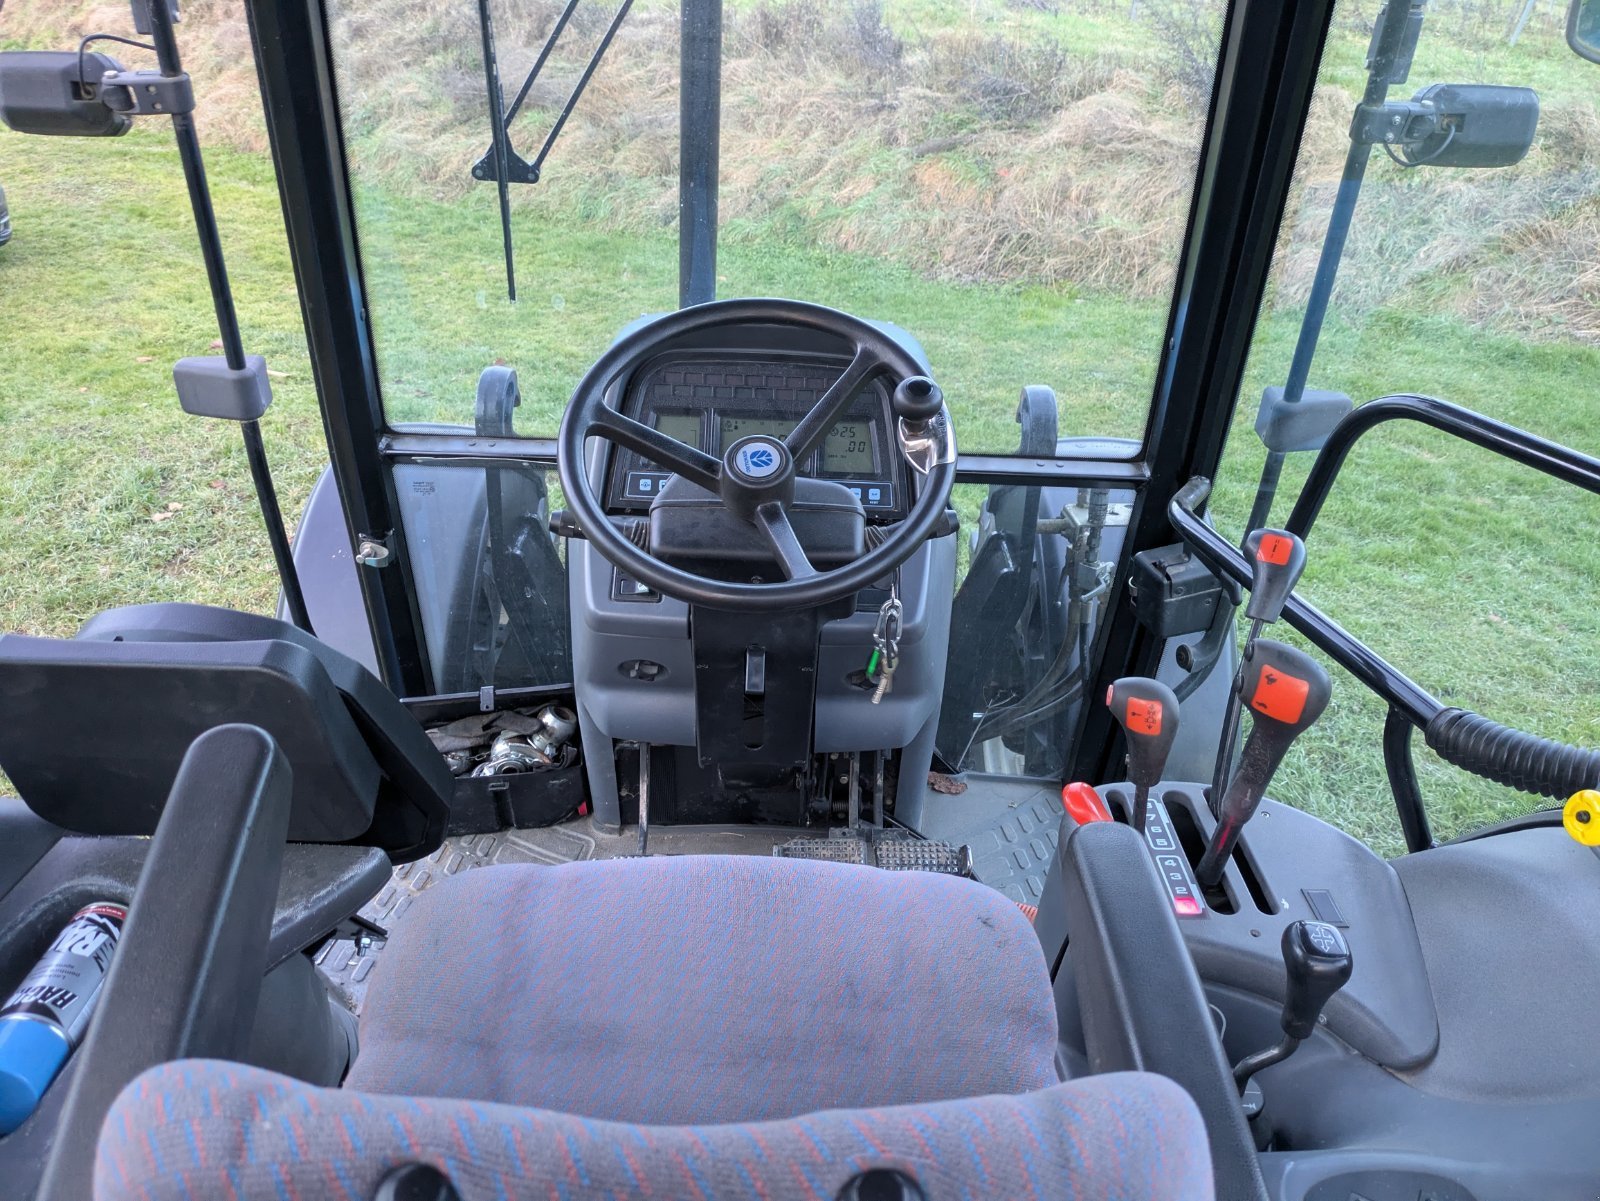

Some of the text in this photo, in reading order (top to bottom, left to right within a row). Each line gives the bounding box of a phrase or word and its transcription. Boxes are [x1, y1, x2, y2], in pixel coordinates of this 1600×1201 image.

[840, 426, 856, 438] 25
[1146, 813, 1156, 821] 7
[1164, 859, 1177, 867] 4
